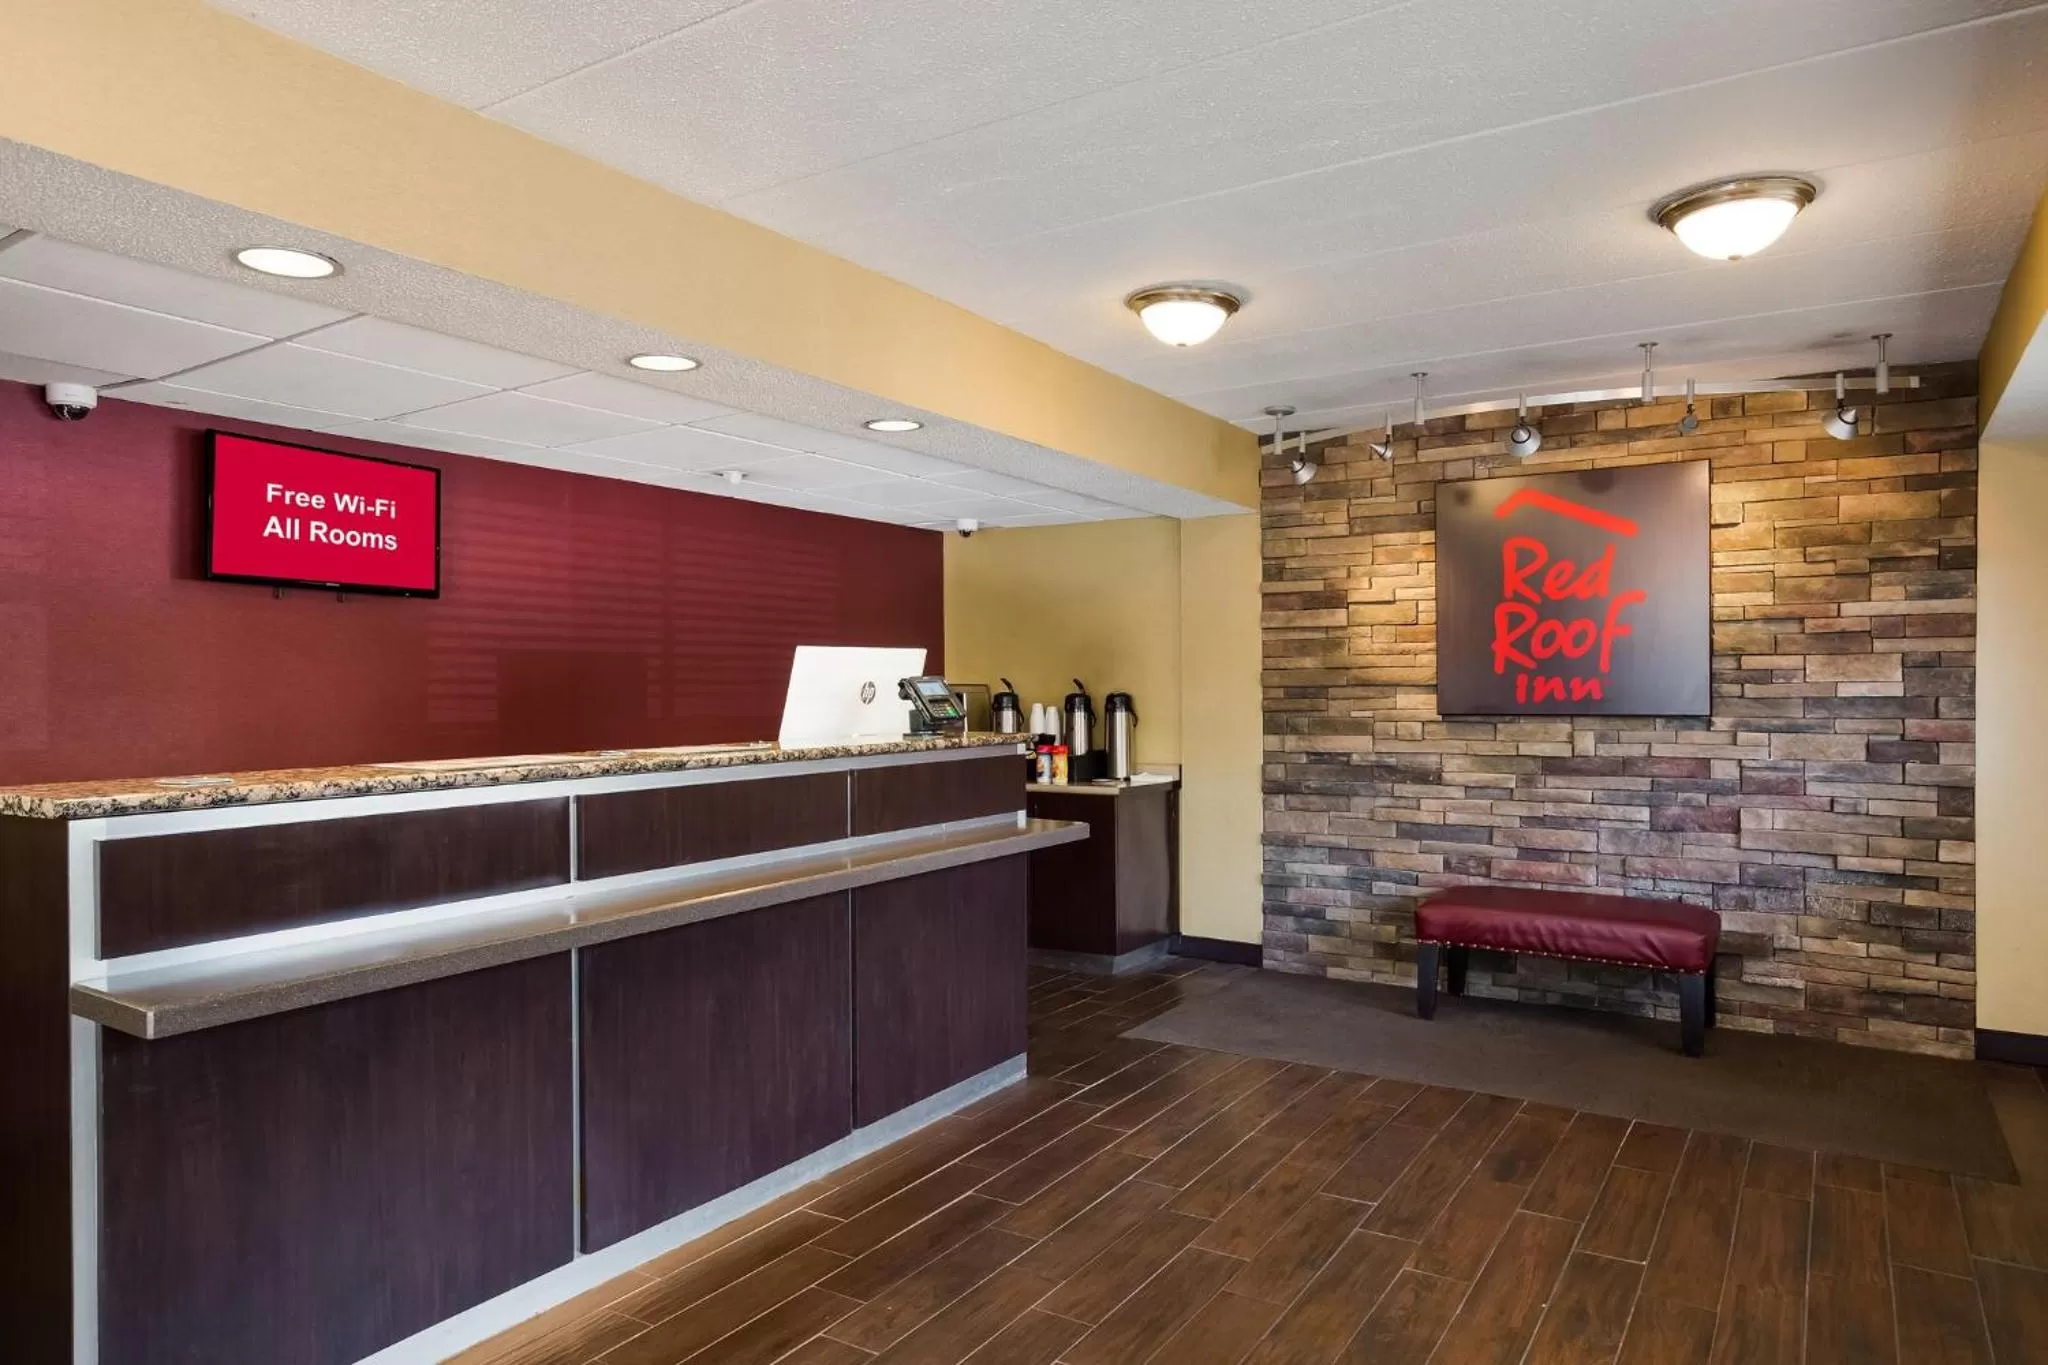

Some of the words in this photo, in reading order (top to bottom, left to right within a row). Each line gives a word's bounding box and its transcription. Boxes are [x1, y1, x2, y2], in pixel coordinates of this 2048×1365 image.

[266, 482, 326, 509] Free
[333, 492, 397, 519] Wi-Fi
[262, 515, 300, 541] All
[309, 520, 398, 551] Rooms
[1502, 536, 1617, 604] Red
[1491, 589, 1647, 674] Roof
[1515, 672, 1604, 705] inn
